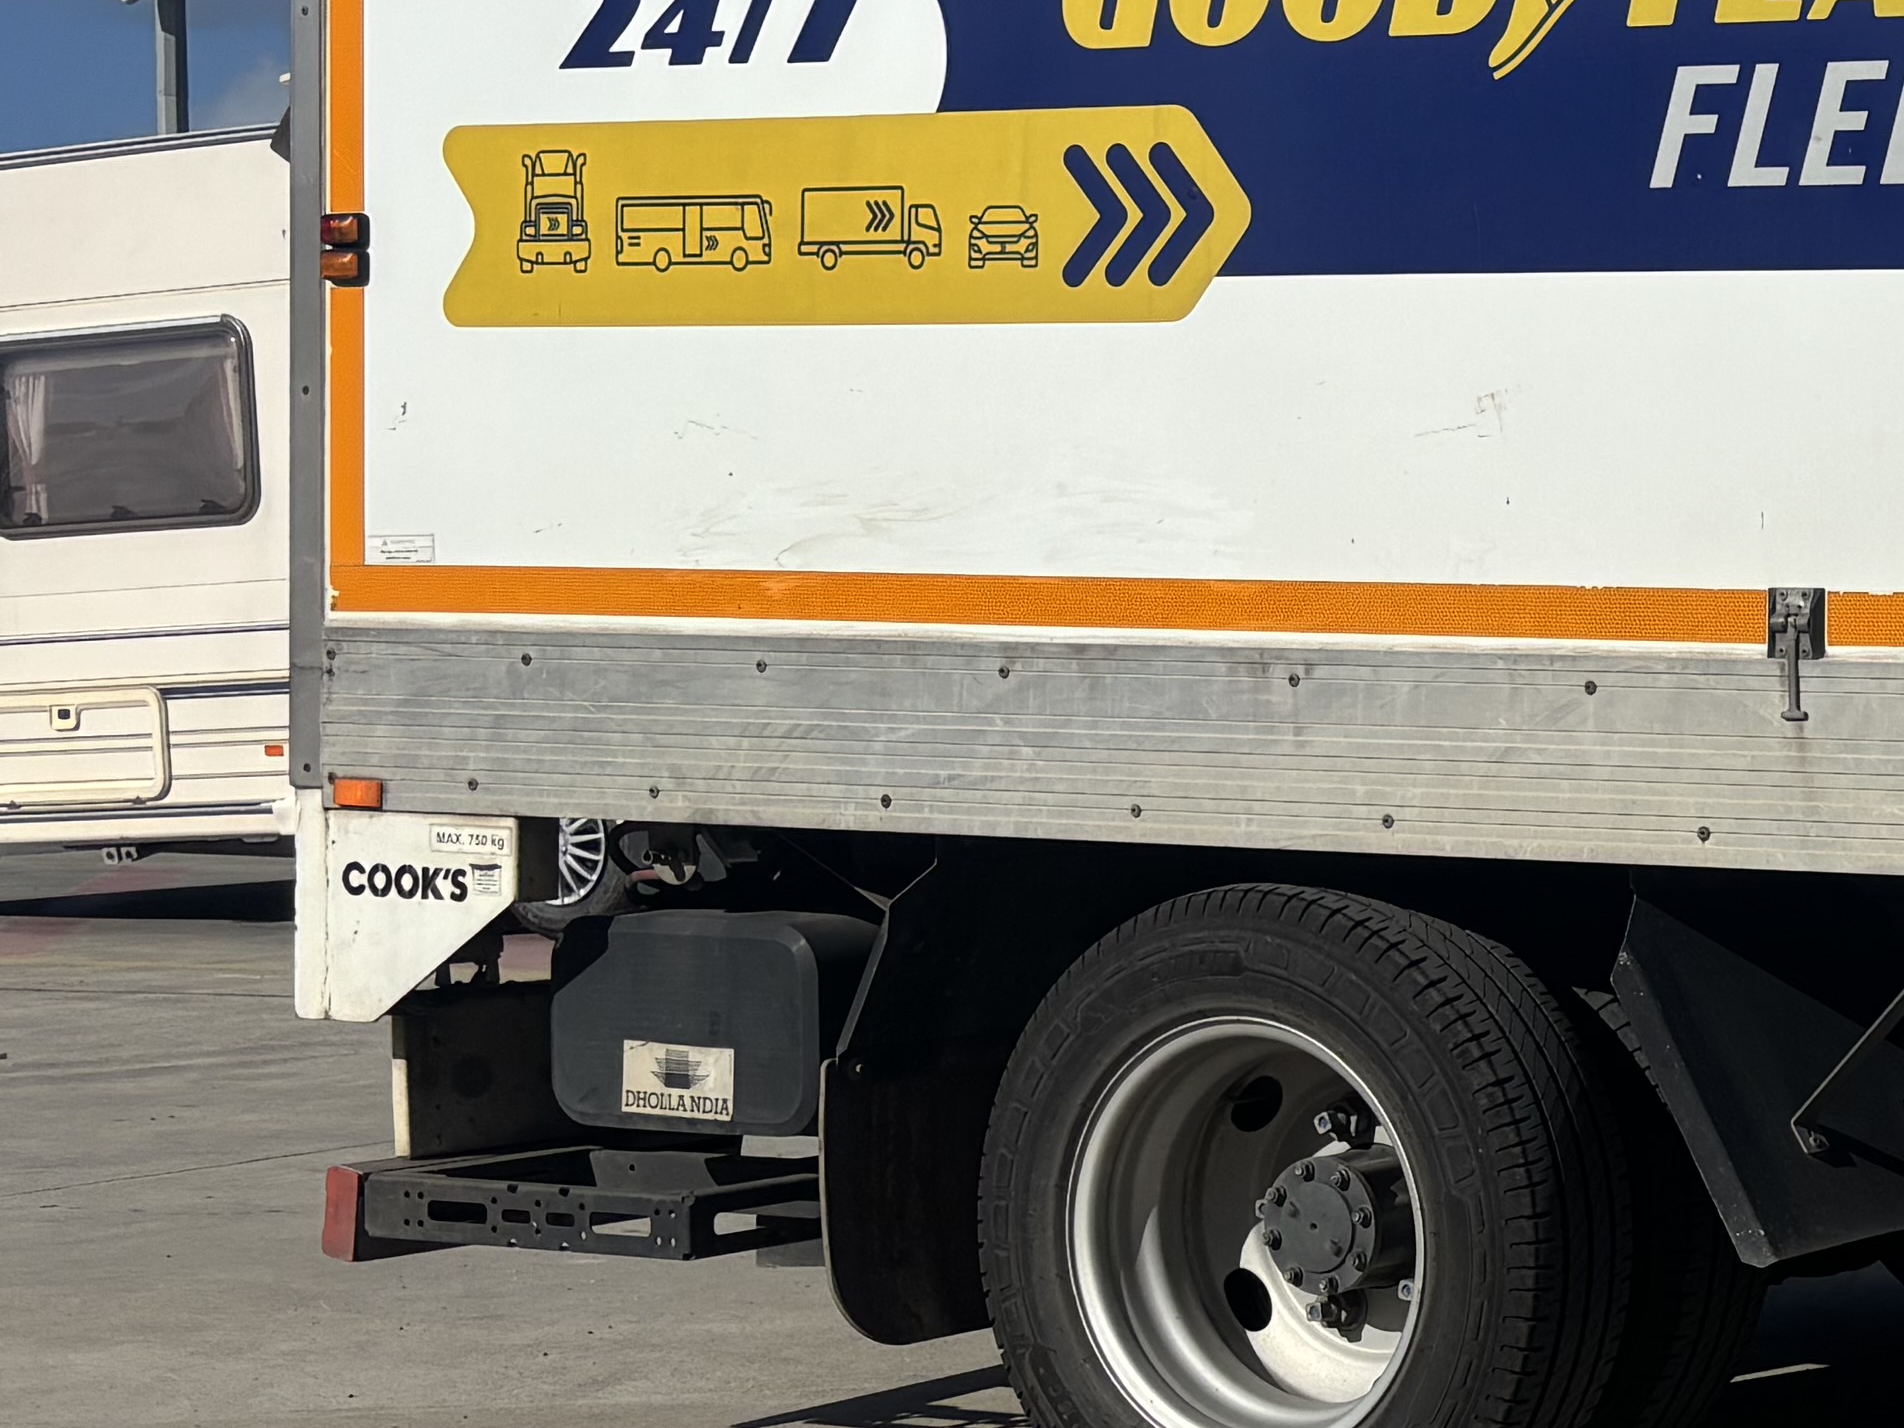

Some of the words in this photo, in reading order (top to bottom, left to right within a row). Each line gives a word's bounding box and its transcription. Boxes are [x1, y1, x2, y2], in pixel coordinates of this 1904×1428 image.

[468, 834, 488, 846] 750
[491, 834, 505, 850] kg
[342, 861, 468, 902] COOK'S
[625, 1089, 730, 1116] DHOLLANDIA
